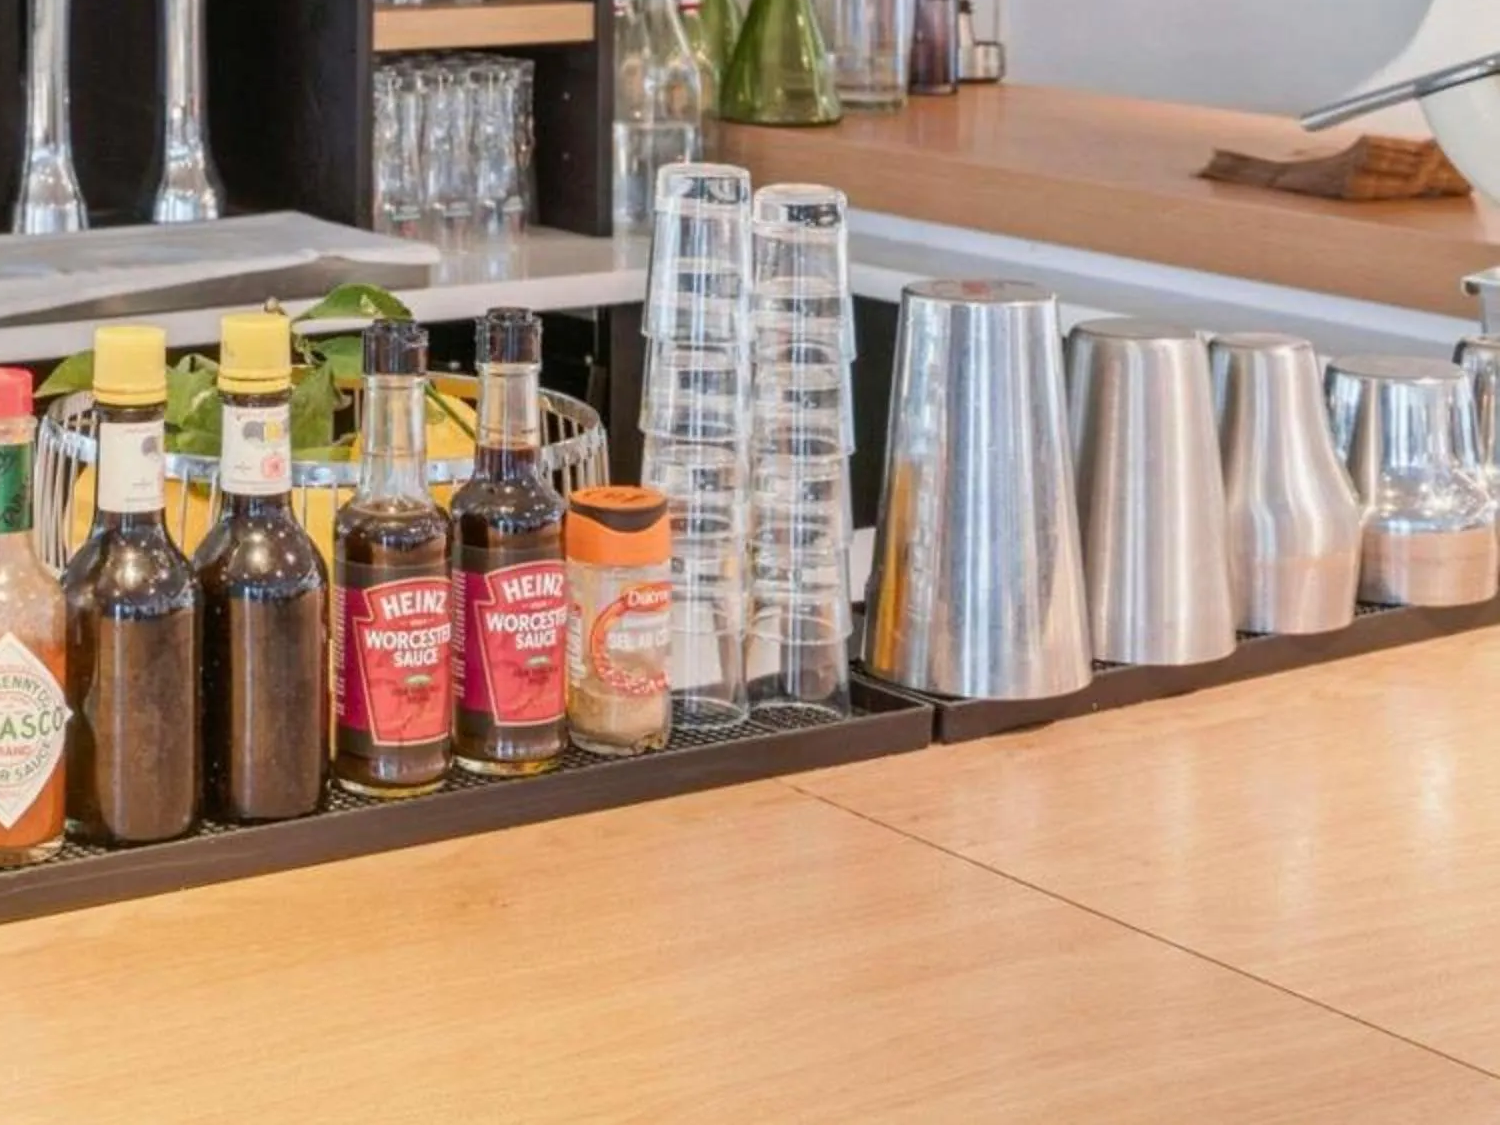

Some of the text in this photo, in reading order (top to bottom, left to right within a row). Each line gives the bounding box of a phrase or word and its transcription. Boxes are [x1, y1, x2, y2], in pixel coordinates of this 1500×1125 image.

[502, 572, 564, 604] HEINZ
[380, 589, 448, 621] HEINZ
[485, 604, 568, 633] WORCESTE
[515, 629, 557, 651] SAUCE
[393, 647, 439, 668] SAUCE
